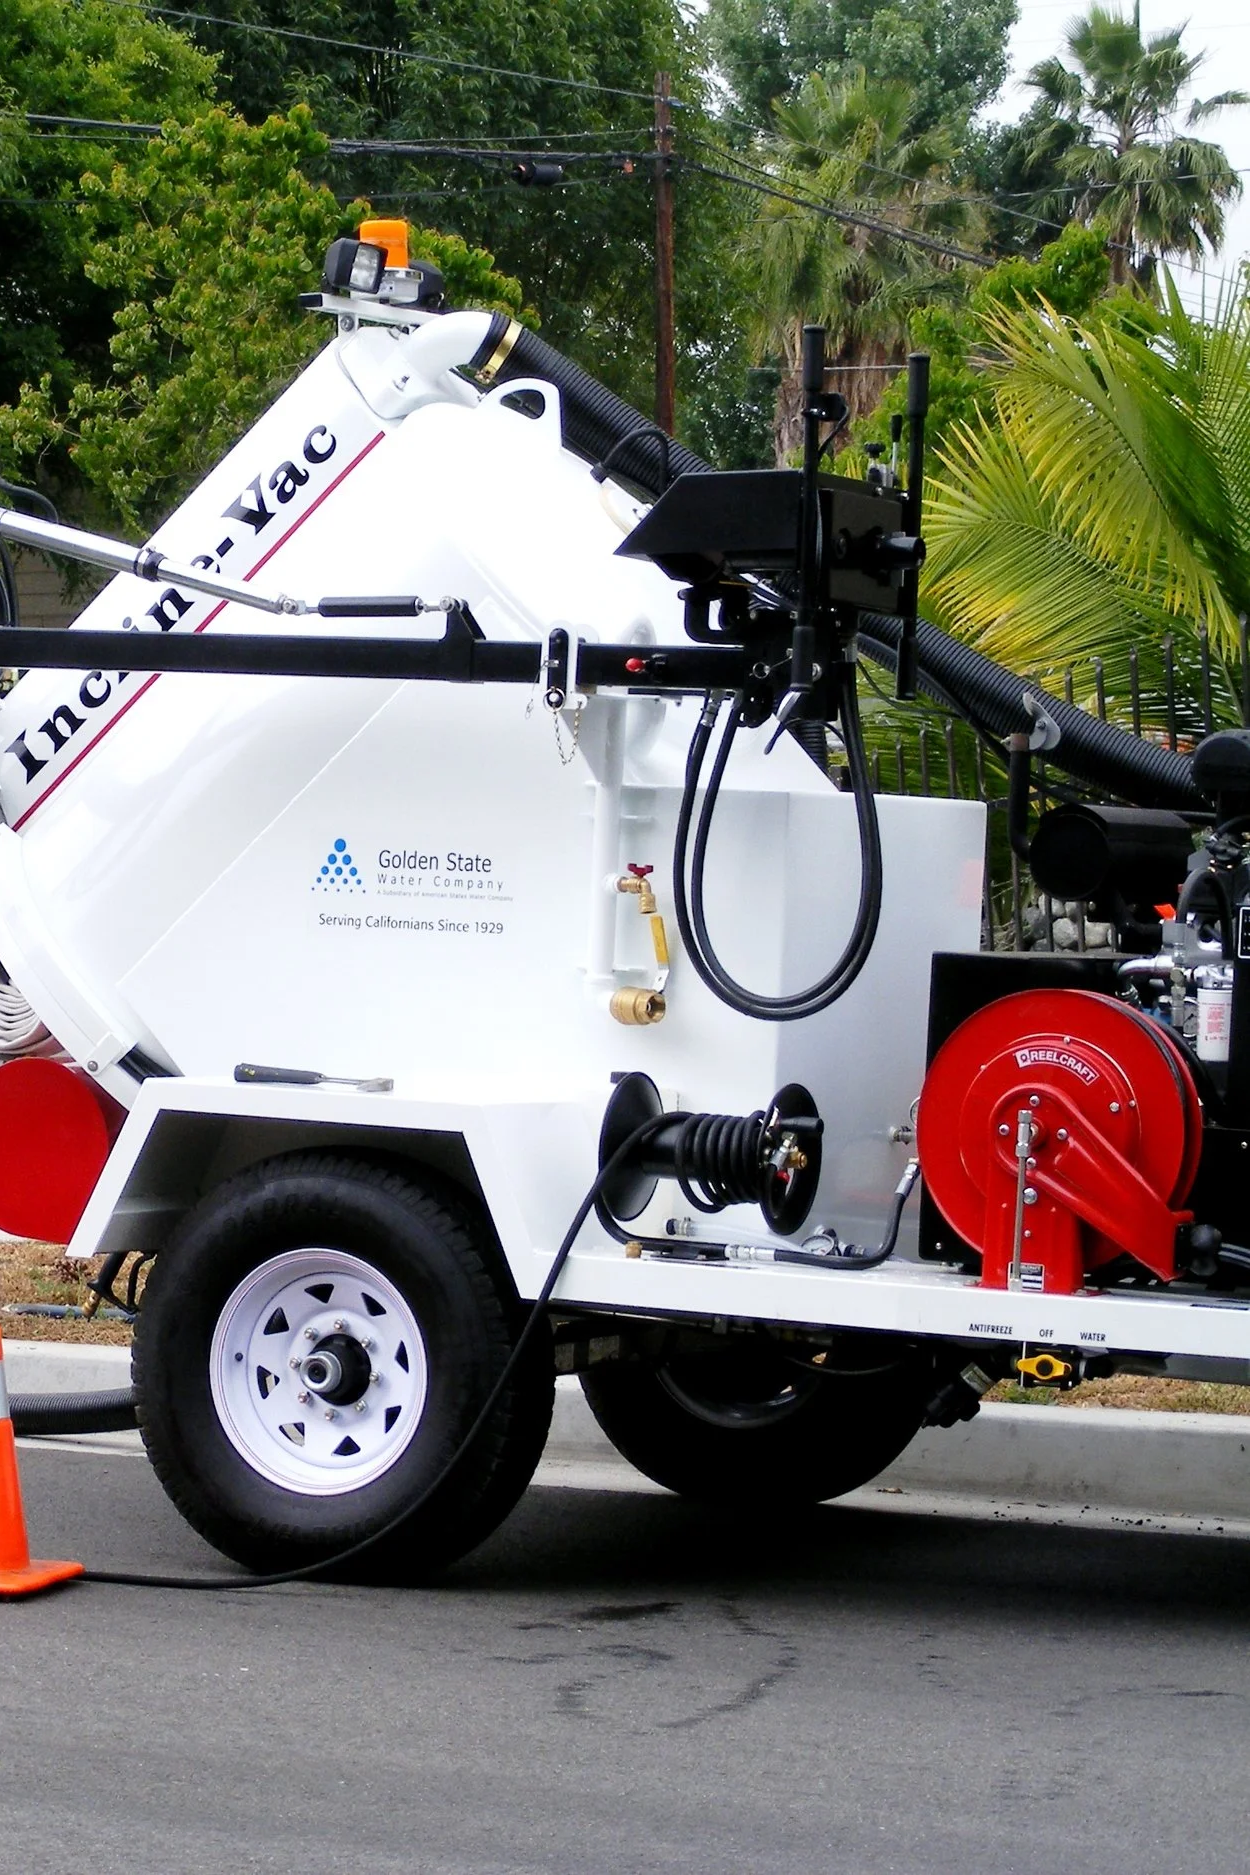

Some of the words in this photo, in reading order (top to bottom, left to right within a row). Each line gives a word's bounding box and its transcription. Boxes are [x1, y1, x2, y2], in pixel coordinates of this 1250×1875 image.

[4, 424, 337, 785] Incne-Vac
[378, 849, 439, 870] Golden
[446, 852, 492, 873] State
[377, 873, 423, 886] Water
[433, 875, 504, 891] Company
[319, 913, 362, 929] Serving
[365, 915, 434, 931] Californians
[438, 919, 470, 932] Since
[475, 921, 504, 934] 1929
[1030, 1050, 1096, 1082] REELCRAFT
[968, 1323, 1013, 1335] ANTIFREEZE
[1039, 1328, 1054, 1338] OFF
[1080, 1332, 1106, 1342] WATER
